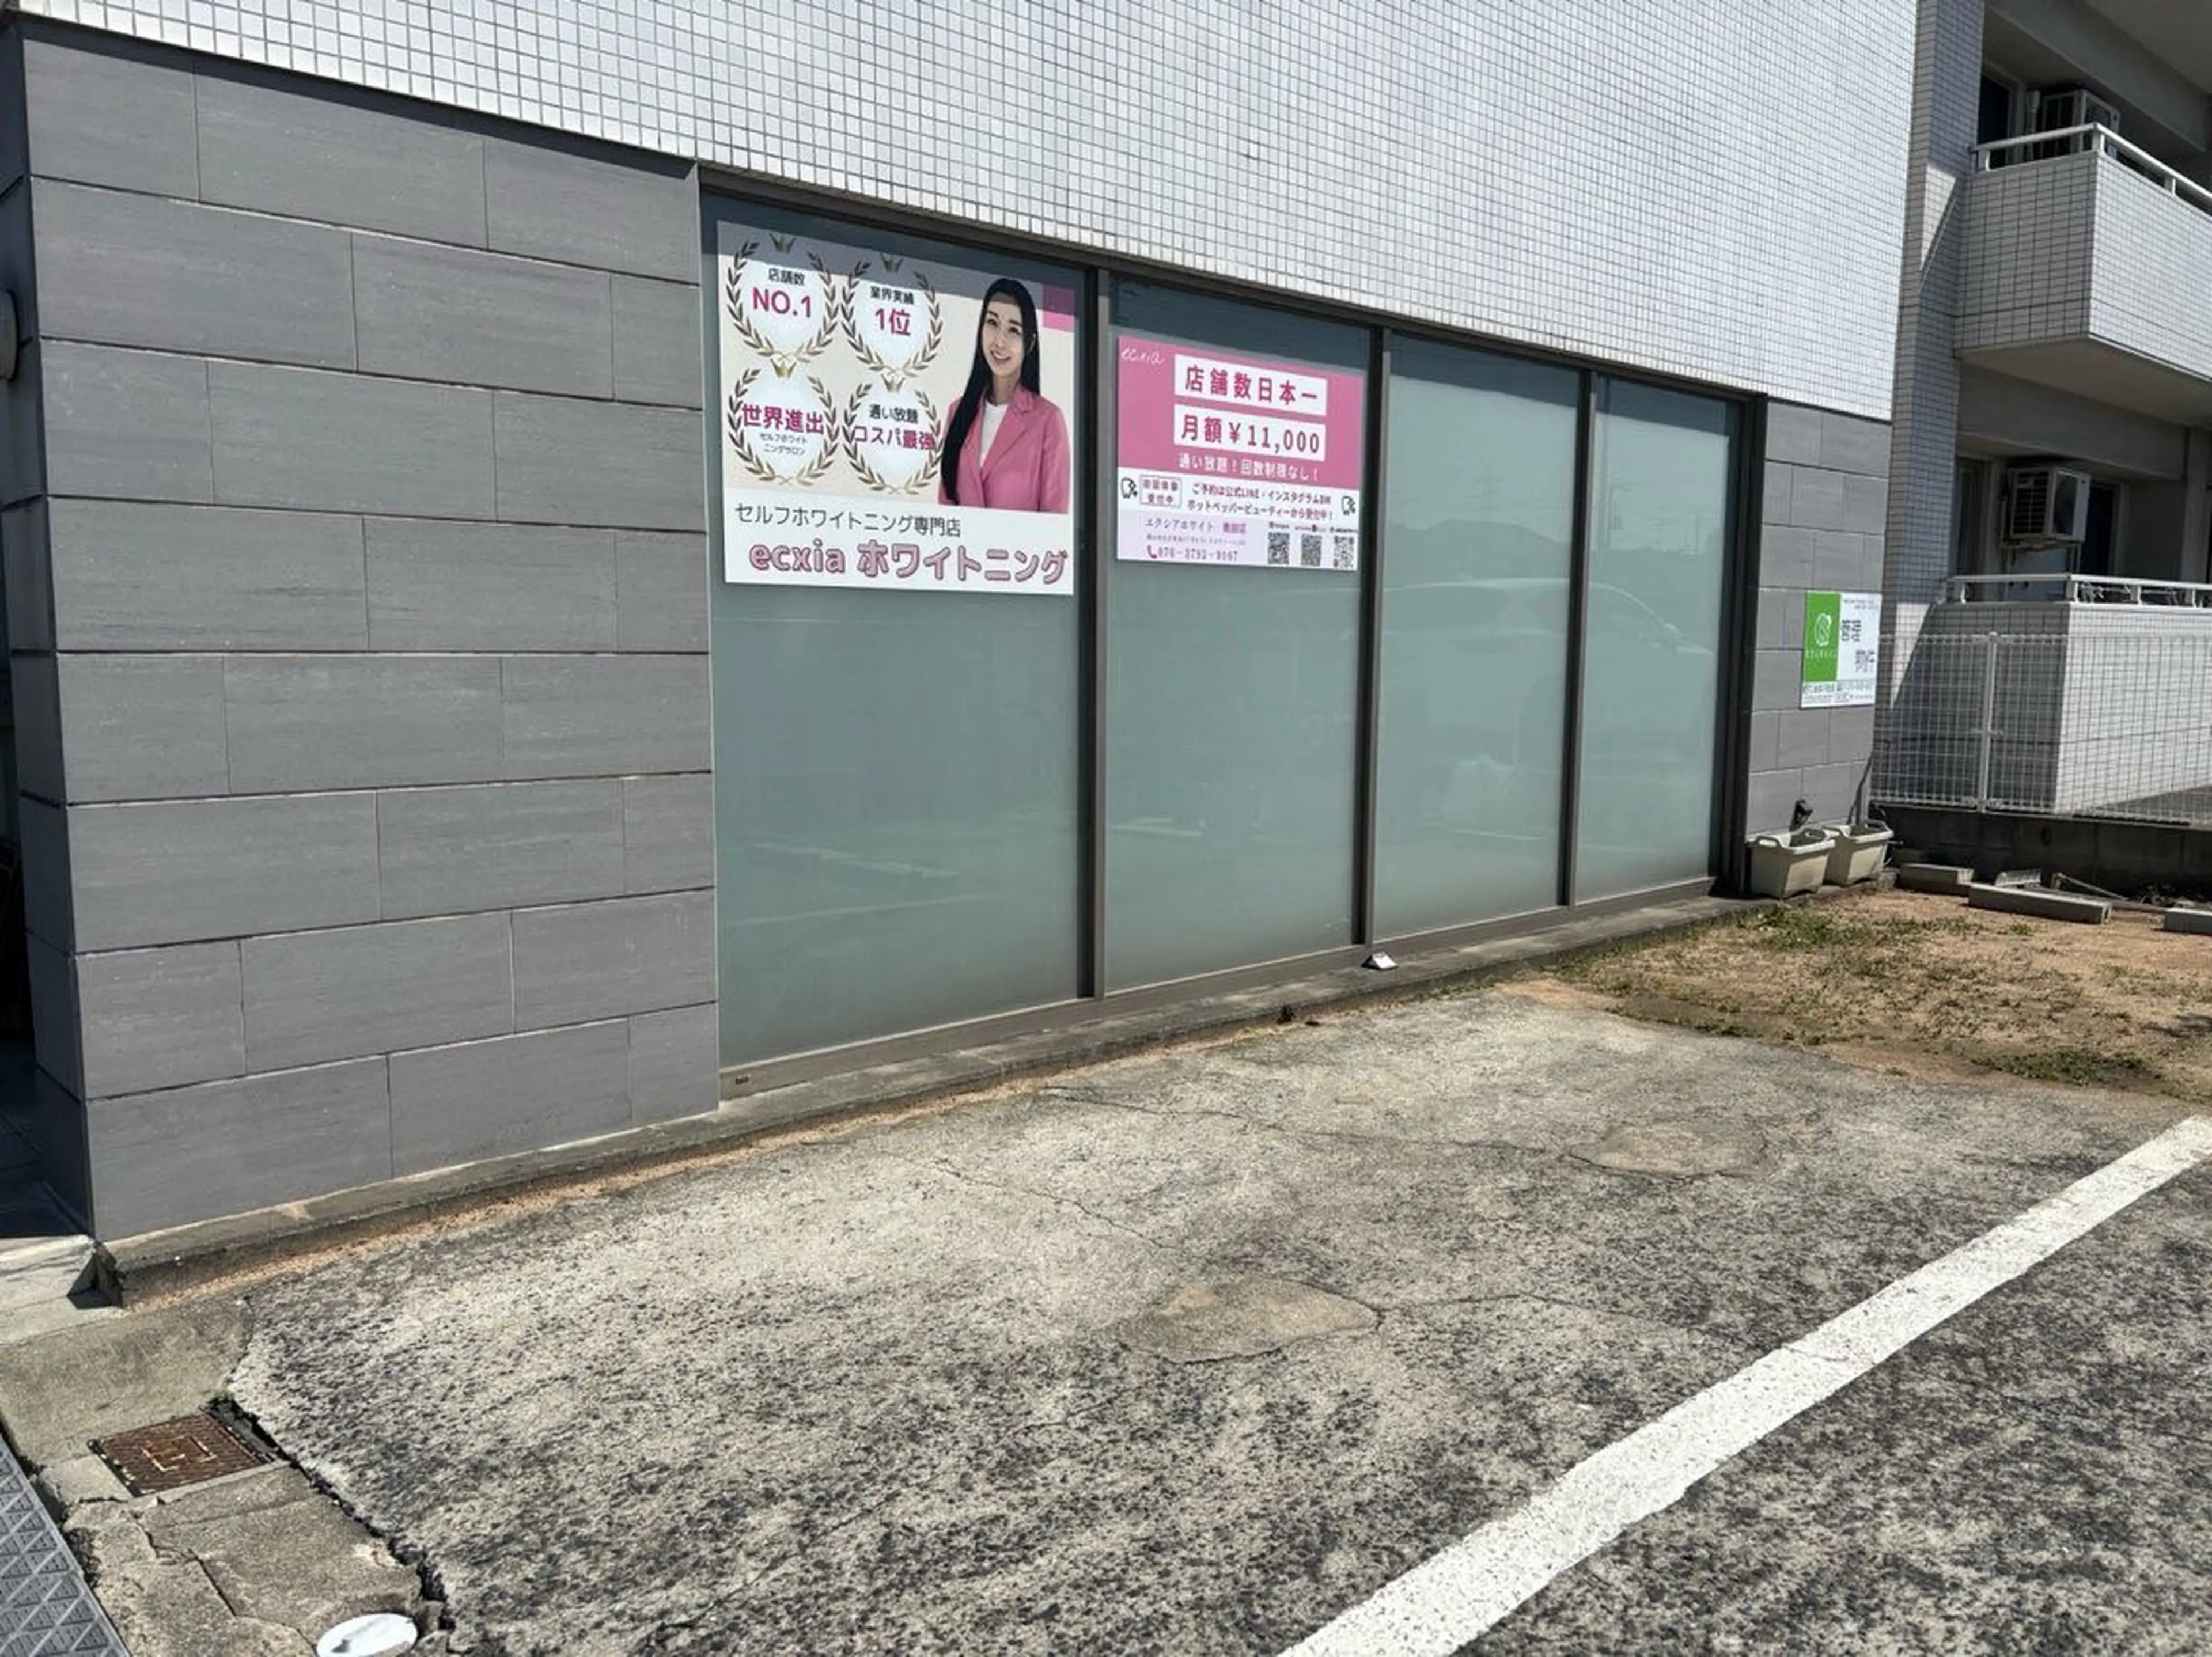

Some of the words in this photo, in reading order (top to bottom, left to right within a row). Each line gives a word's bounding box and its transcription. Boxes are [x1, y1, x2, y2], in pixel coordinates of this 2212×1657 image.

[768, 267, 805, 286] 店舗数
[752, 286, 811, 318] NO.1
[874, 308, 911, 337] 1位
[1184, 365, 1318, 406] 店舗数日本一
[742, 403, 824, 435] 世界進出
[869, 404, 919, 424] 通い放題
[854, 427, 937, 452] コスパ最強
[735, 505, 961, 538] セルフホワイトニング専門店
[749, 539, 846, 574] ecxia
[857, 540, 1068, 586] ホワイトニング
